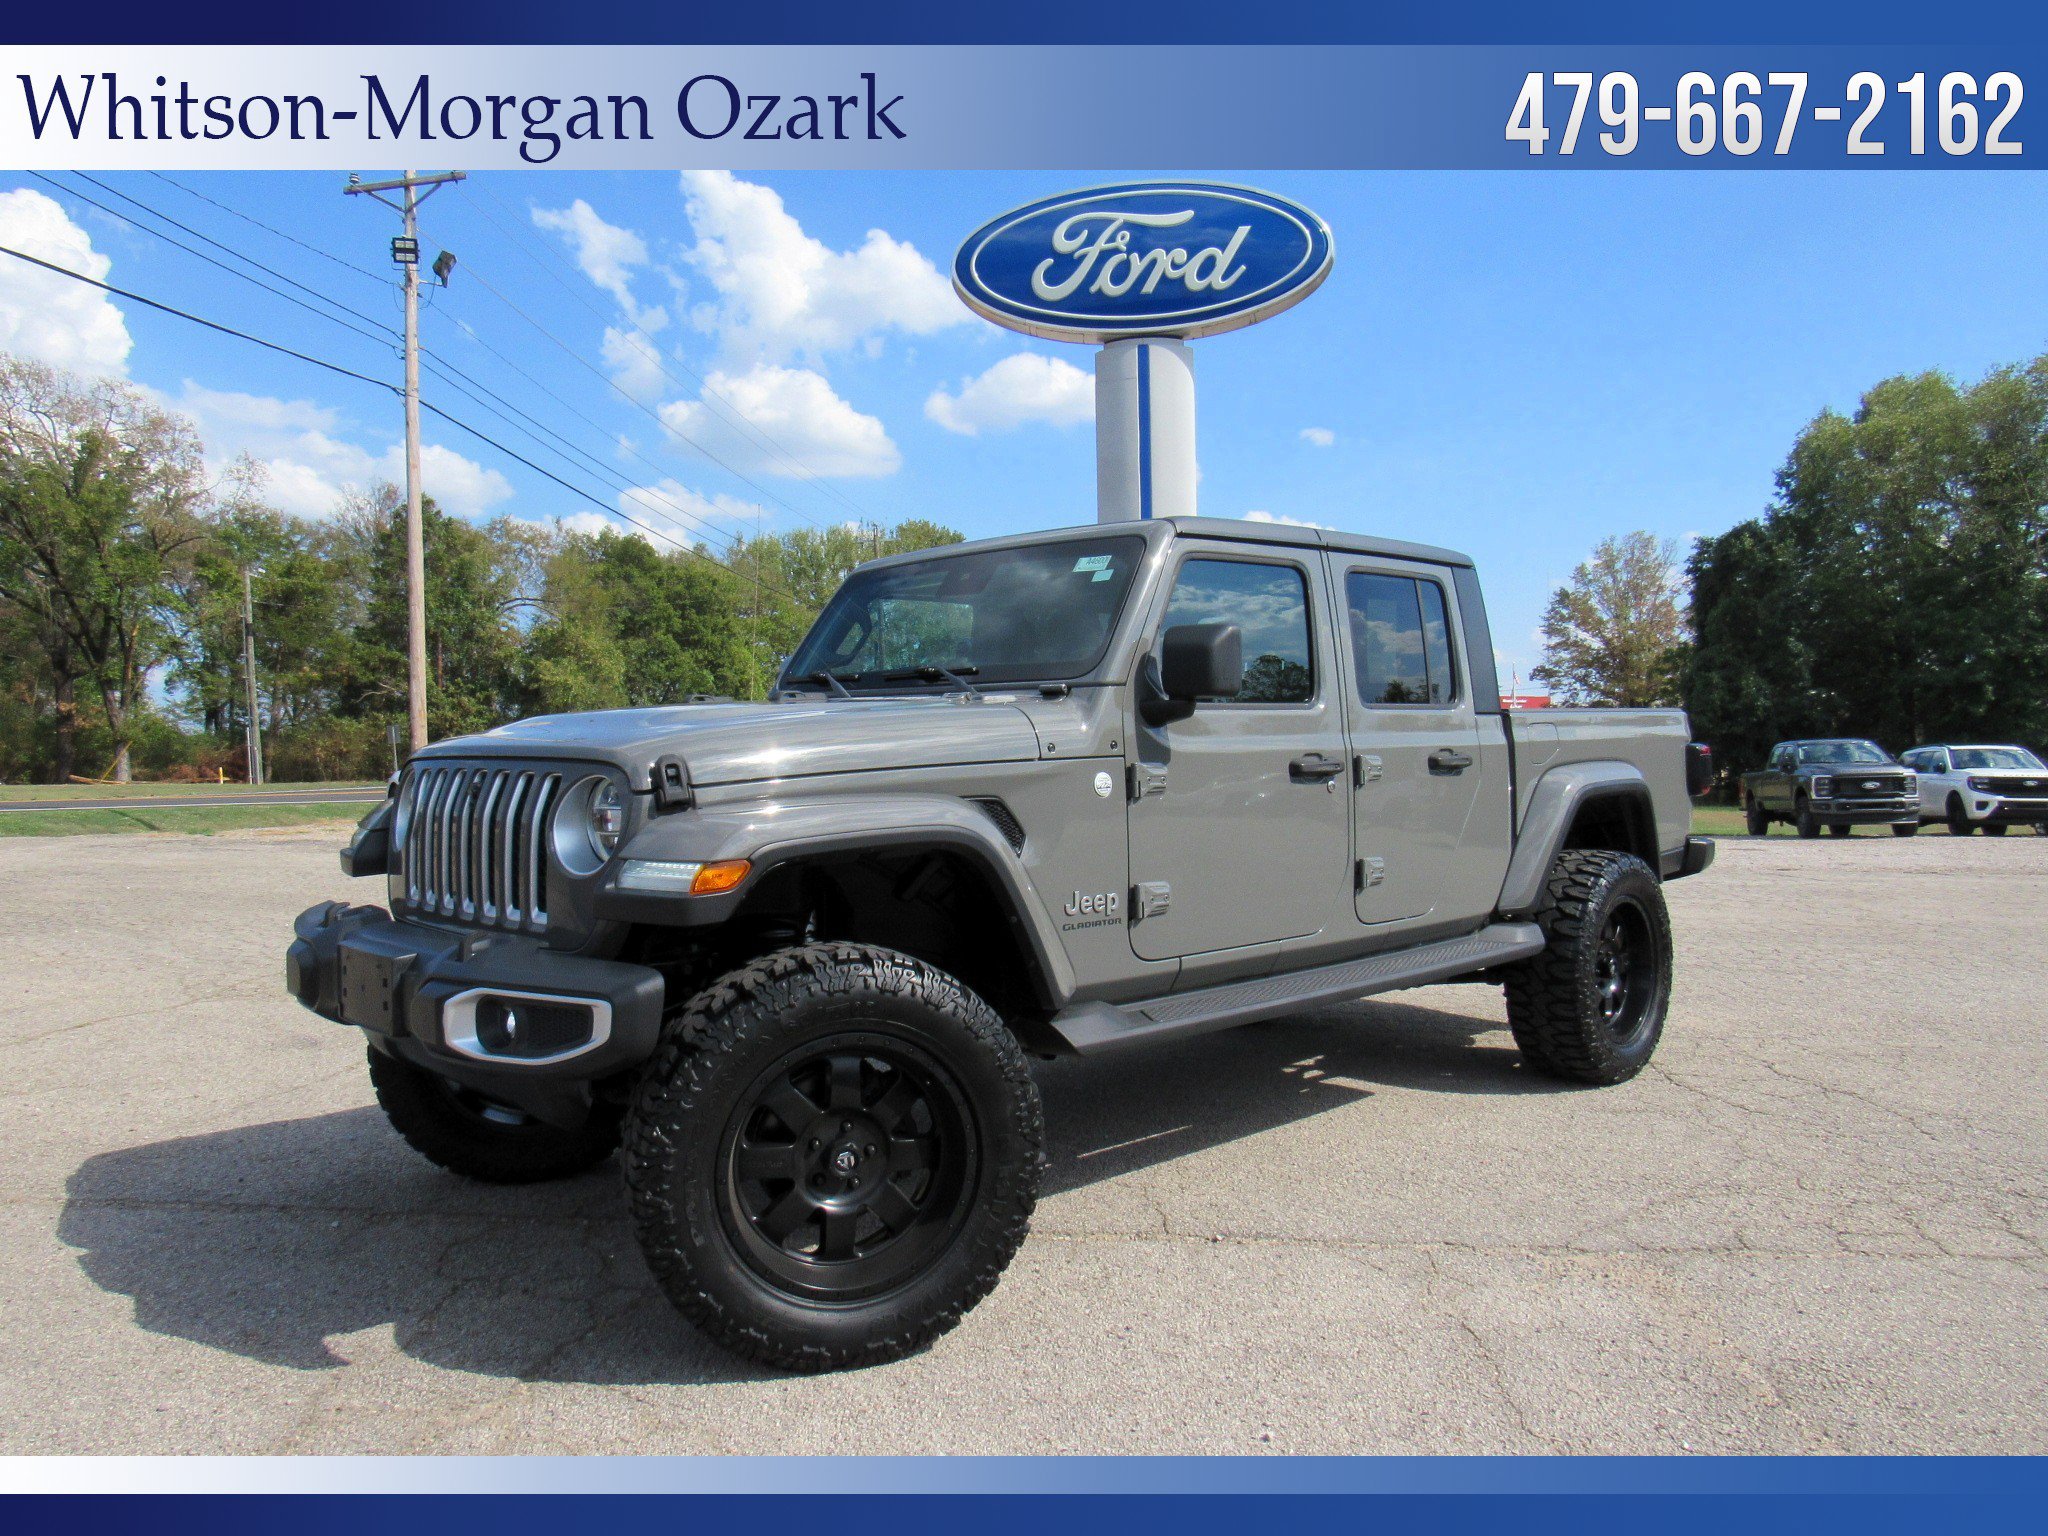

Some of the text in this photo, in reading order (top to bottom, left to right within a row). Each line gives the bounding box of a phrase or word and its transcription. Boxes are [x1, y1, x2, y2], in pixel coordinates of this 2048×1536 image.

[1031, 209, 1252, 301] Ford
[1064, 890, 1120, 916] Jeep
[1062, 917, 1122, 931] GLADIATOR
